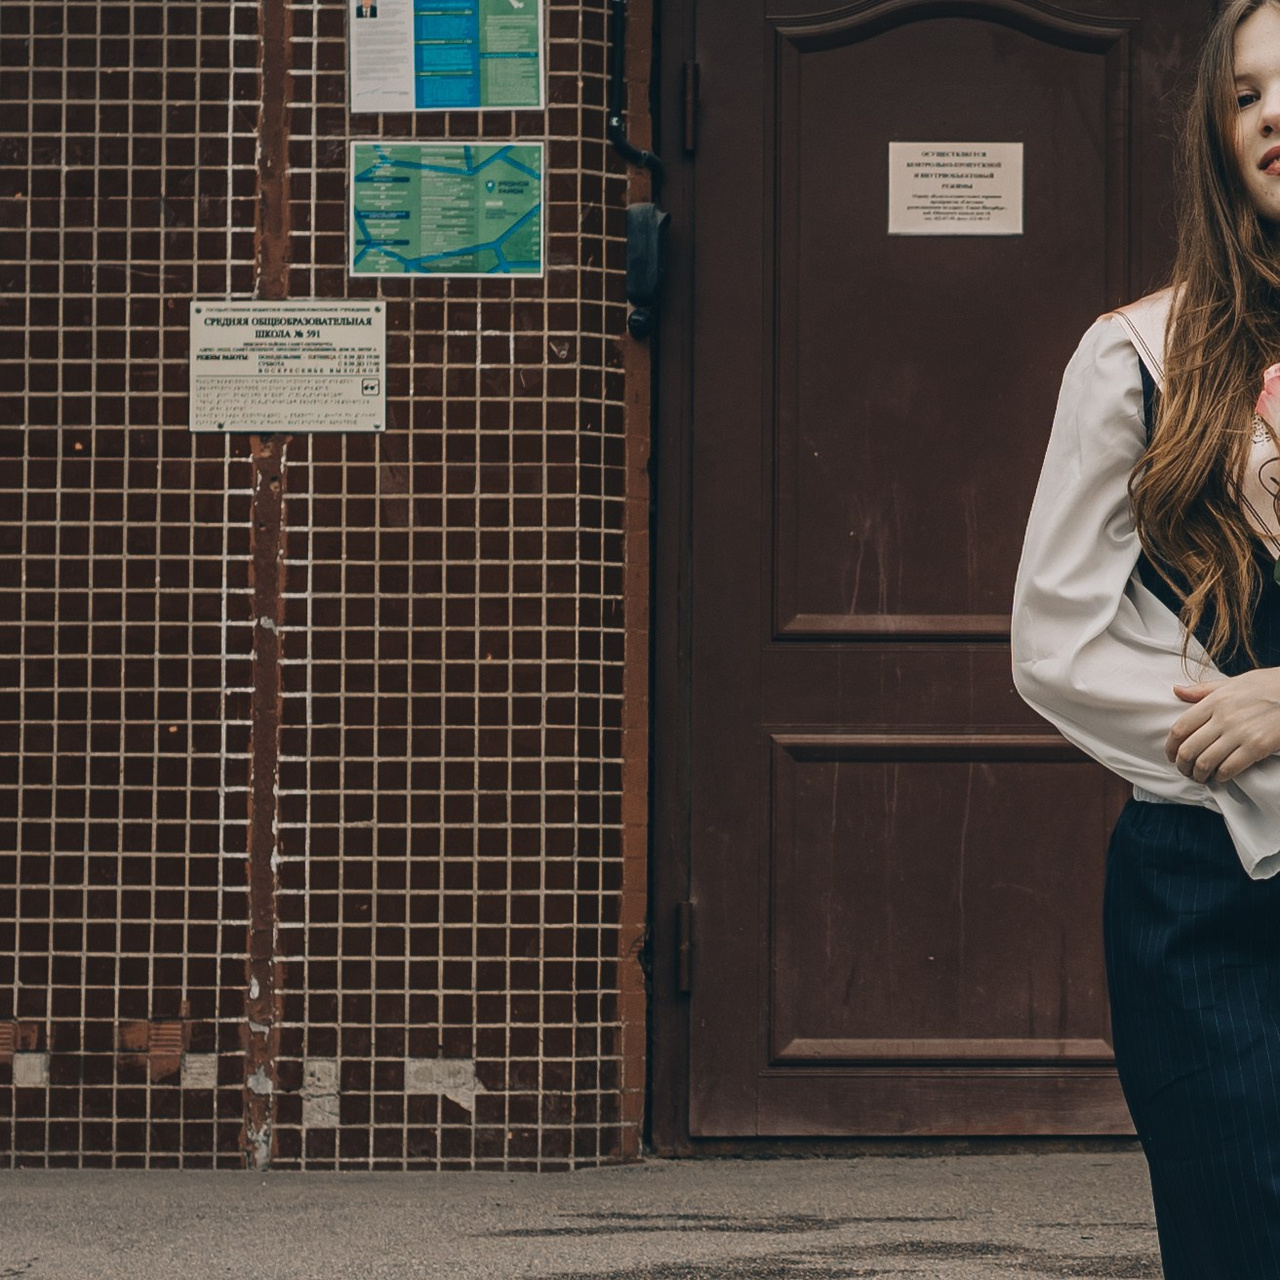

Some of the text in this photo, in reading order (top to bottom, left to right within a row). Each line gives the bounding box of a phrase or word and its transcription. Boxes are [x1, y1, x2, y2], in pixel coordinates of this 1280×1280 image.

[203, 317, 373, 327] СРЕДНЯЯ ОБЩЕОБРАЗОВАТЕЛЬНАЯ
[255, 329, 292, 339] ШКОЛА
[306, 329, 321, 339] 591
